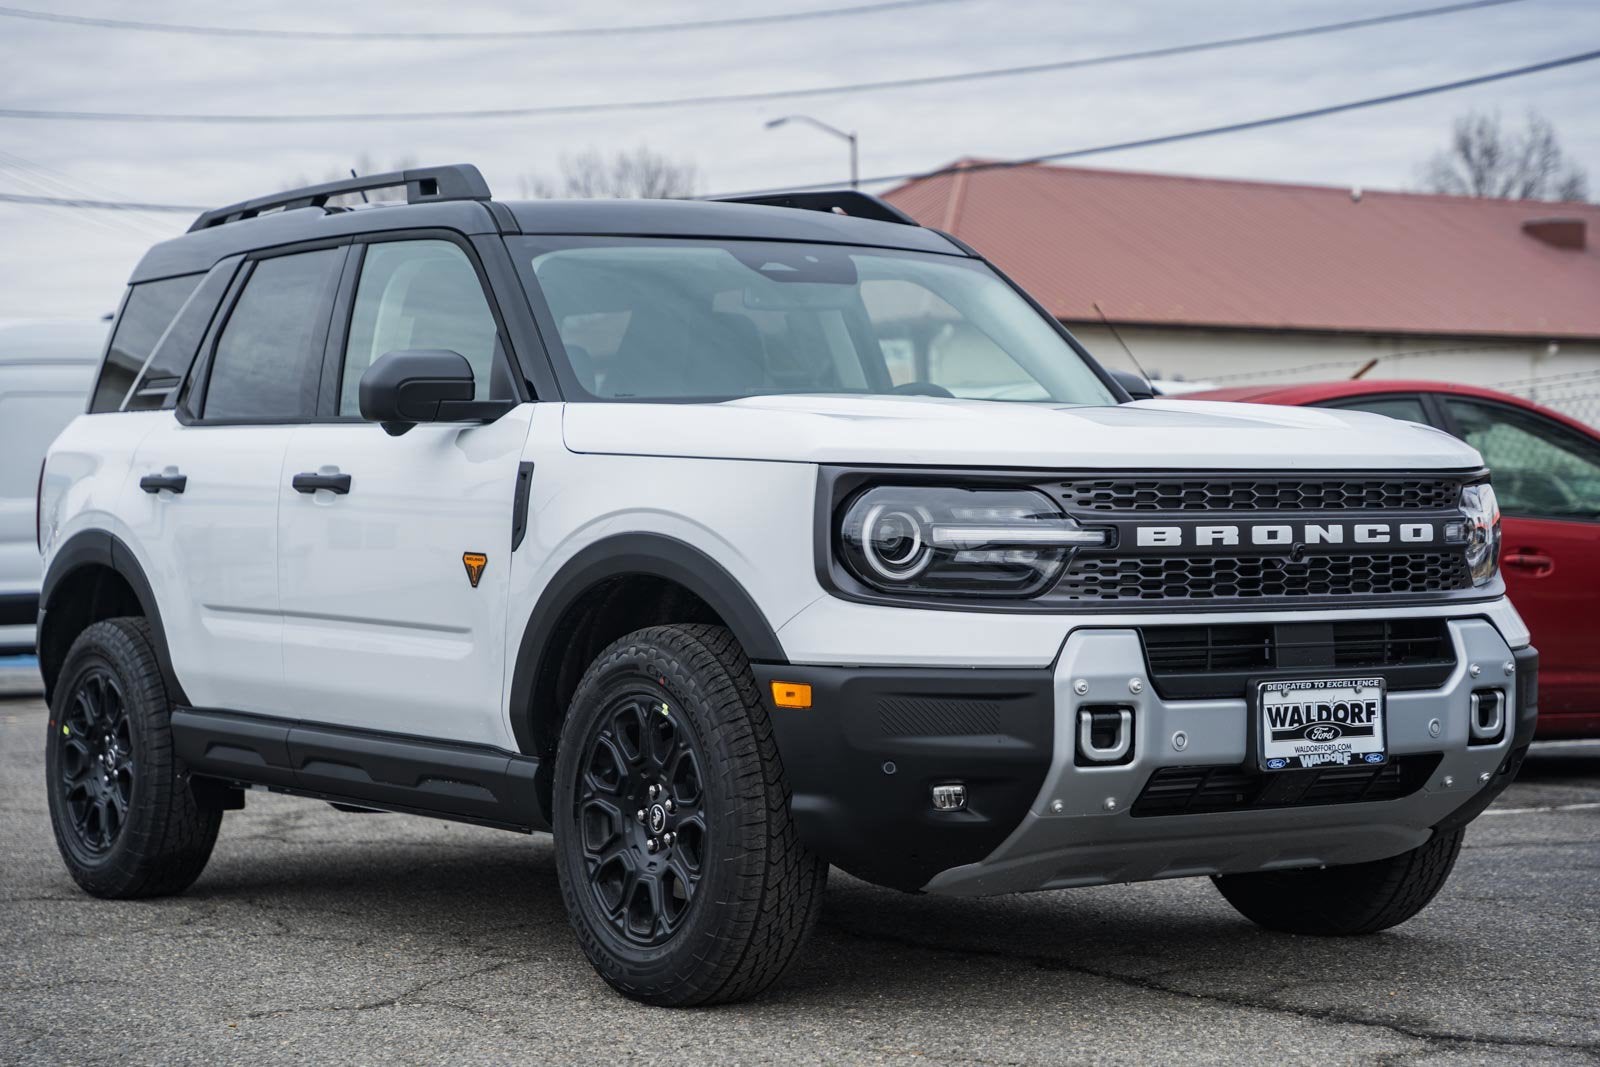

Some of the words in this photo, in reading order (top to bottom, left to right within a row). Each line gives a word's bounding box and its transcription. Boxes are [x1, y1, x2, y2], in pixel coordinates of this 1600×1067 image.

[1136, 523, 1434, 547] BRONCO
[1267, 682, 1312, 691] DEDICATED
[1326, 680, 1380, 688] EXCELLENCE
[1265, 700, 1377, 728] WALDORF
[1311, 727, 1335, 740] Ford
[1294, 743, 1352, 753] WALDORFFORD.COM
[1299, 751, 1352, 768] WALDORF
